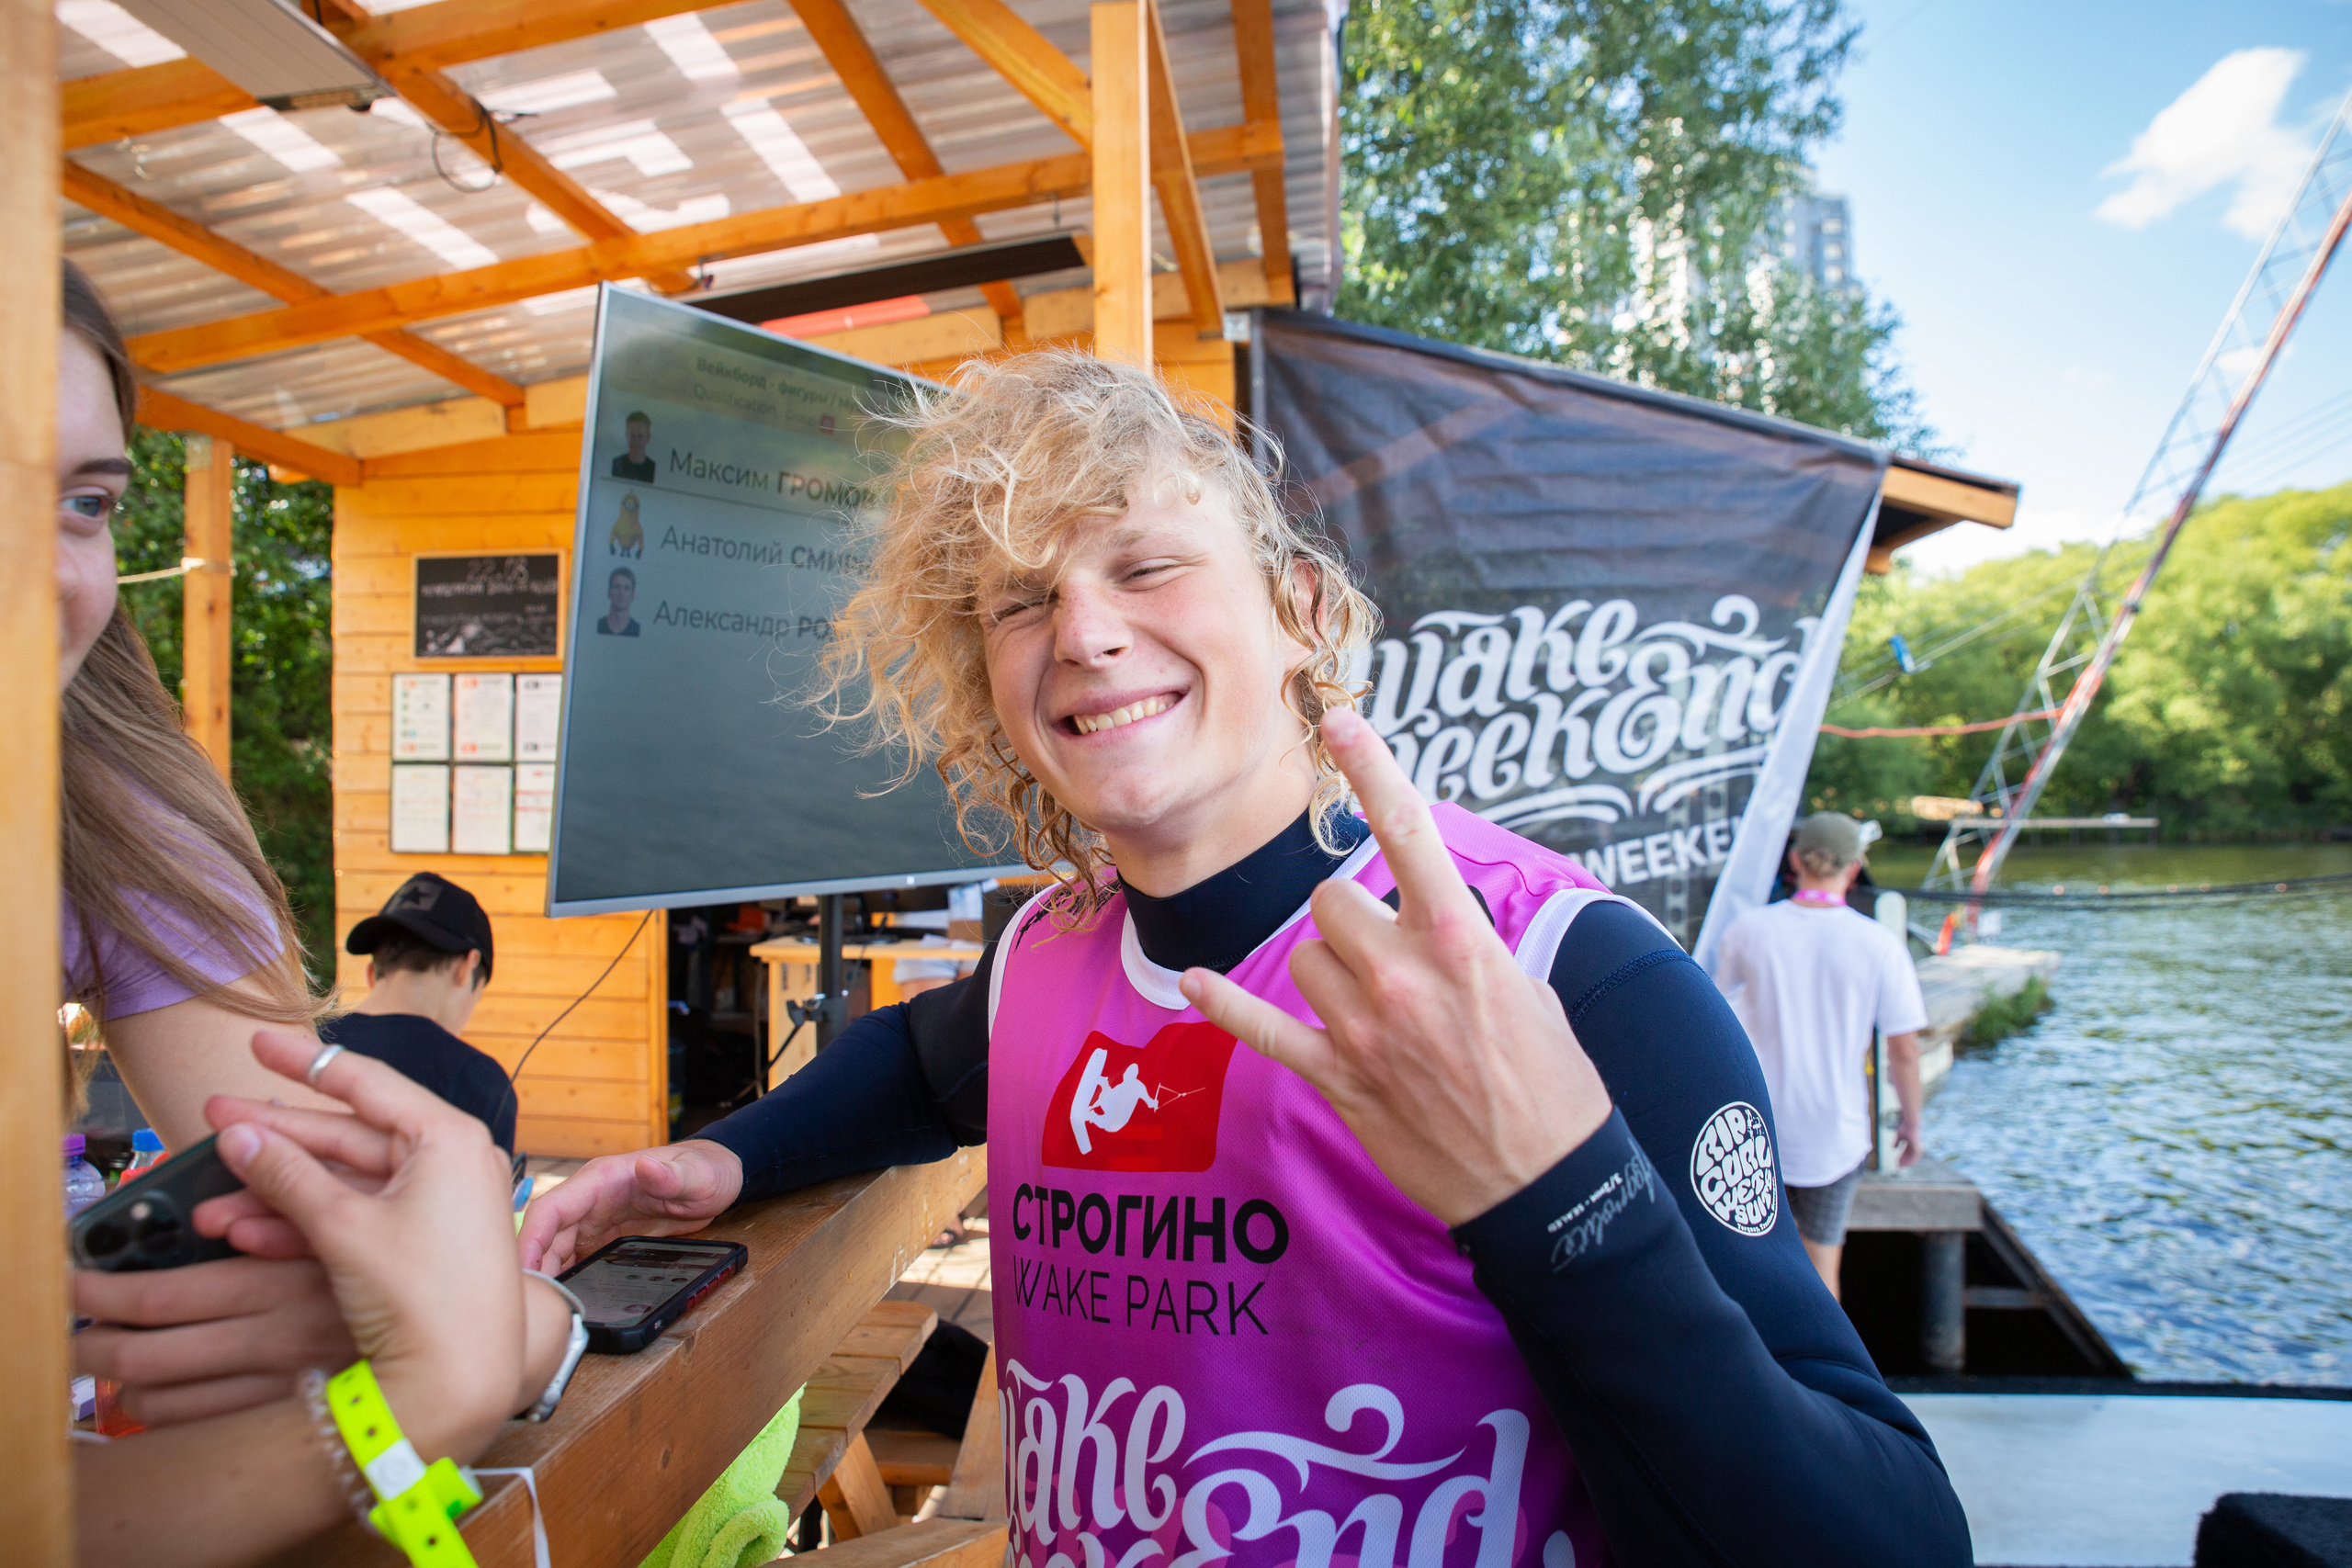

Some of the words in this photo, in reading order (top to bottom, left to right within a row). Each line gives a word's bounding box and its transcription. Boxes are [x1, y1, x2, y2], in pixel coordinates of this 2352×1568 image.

[669, 448, 769, 491] Максим
[661, 525, 783, 565] Анатолий
[653, 600, 790, 640] Александр
[1696, 1109, 1747, 1177] RIP
[1701, 1135, 1772, 1206] CURL
[1012, 1183, 1289, 1265] СТРОГИНО
[1013, 1255, 1111, 1325] WAKE
[1125, 1274, 1270, 1337] PARK
